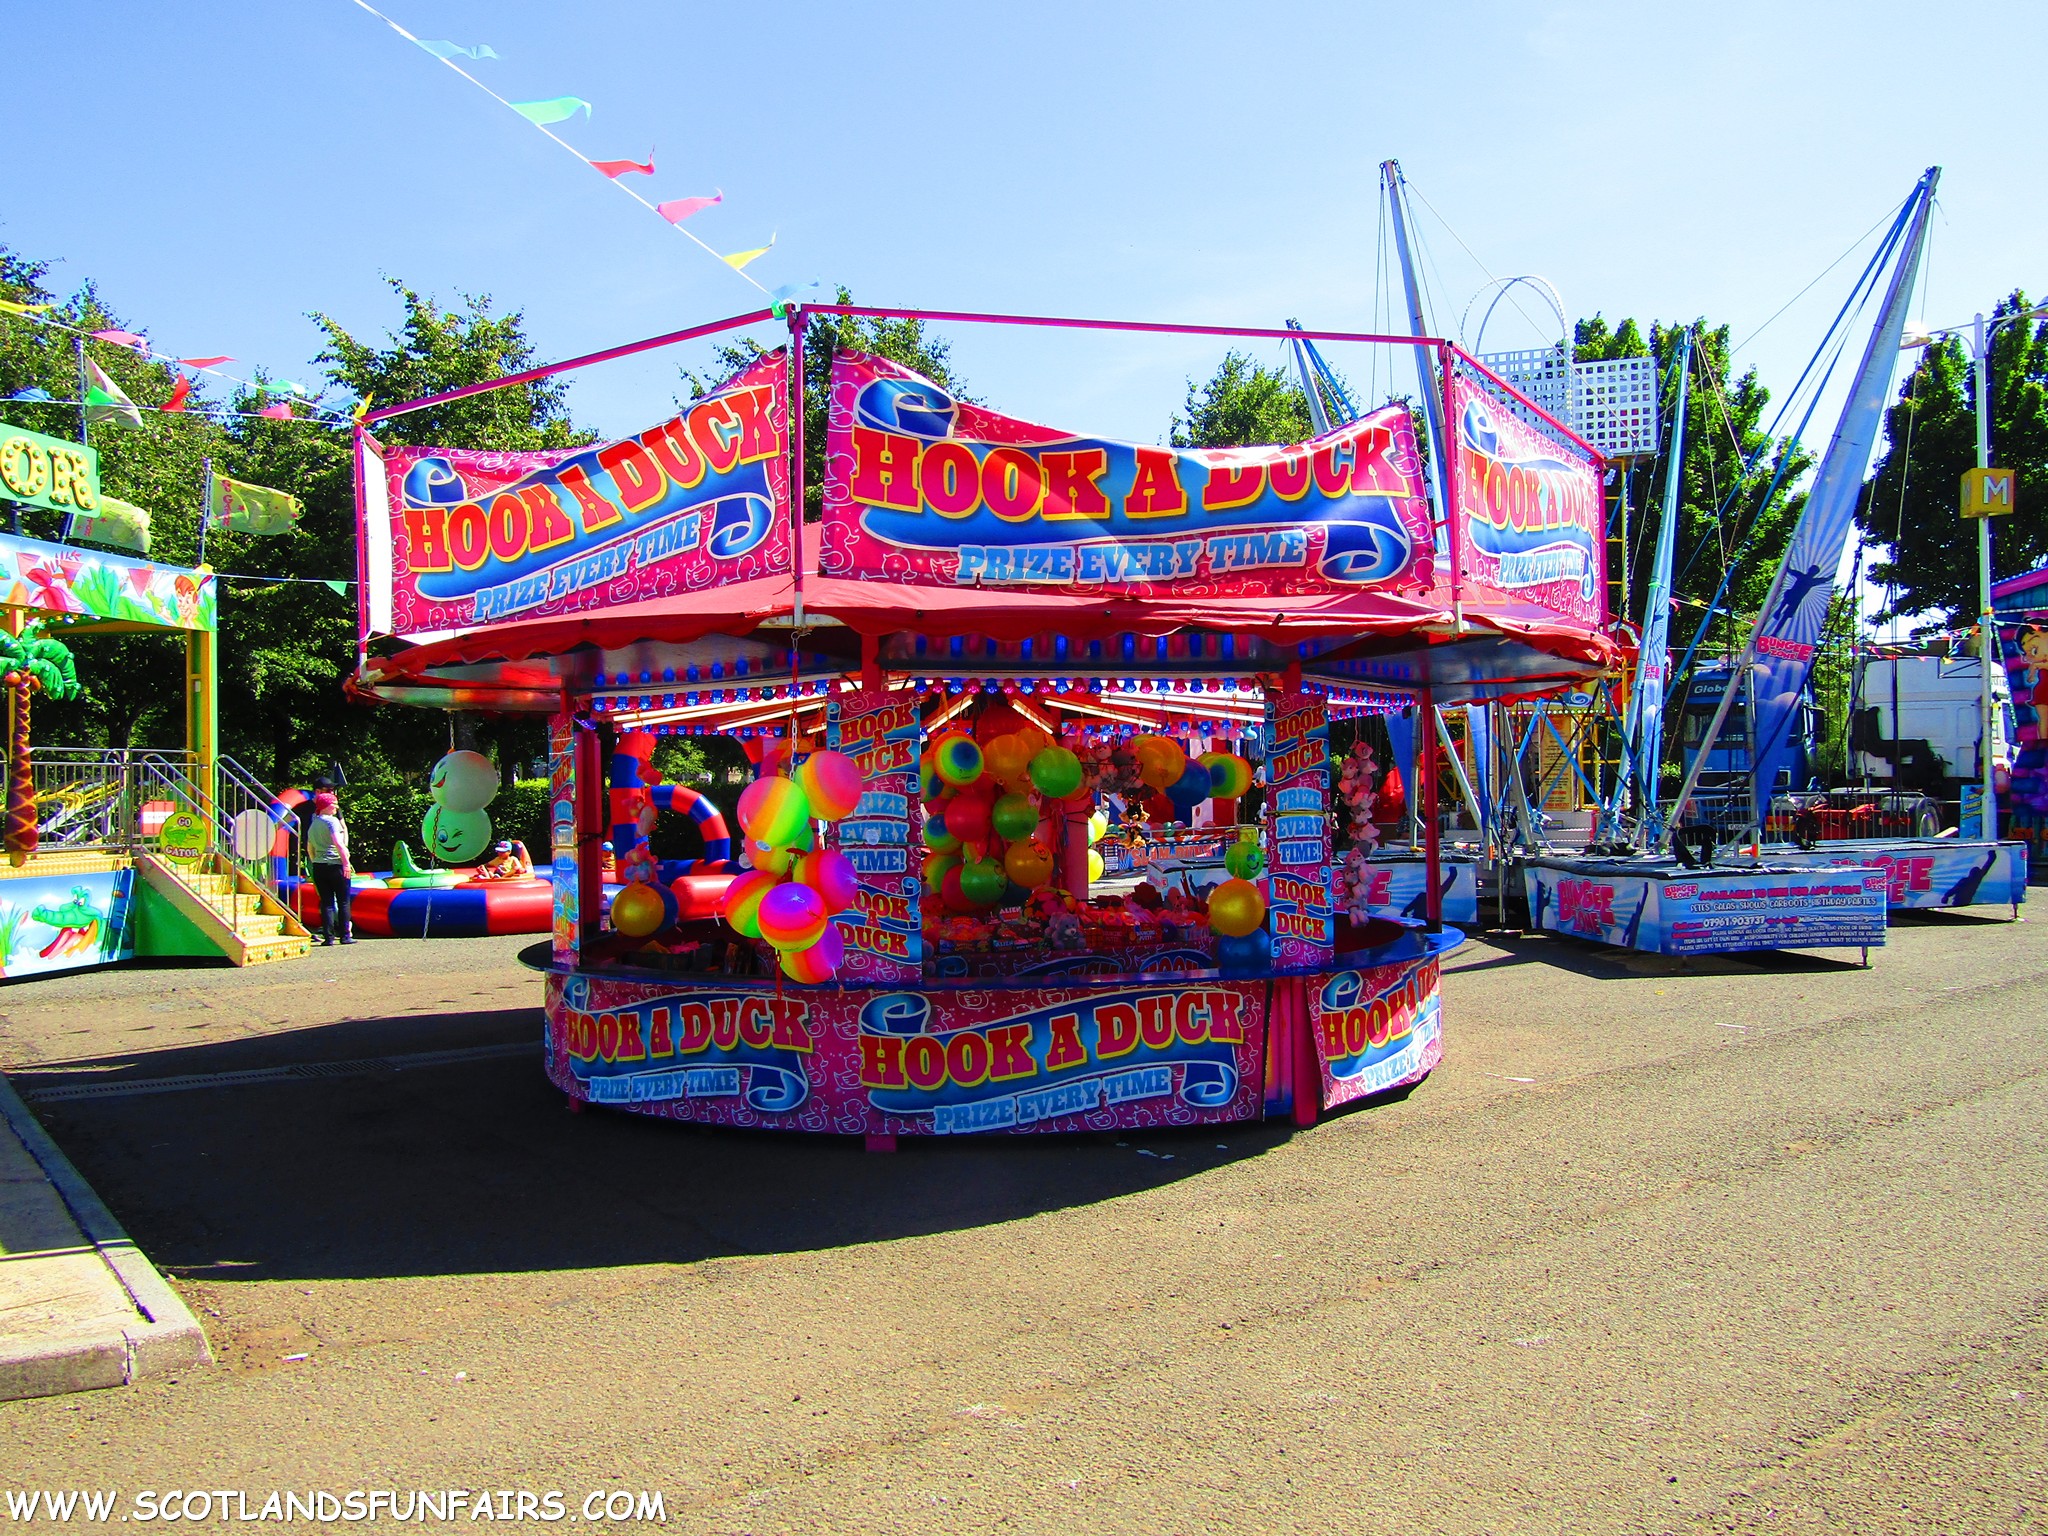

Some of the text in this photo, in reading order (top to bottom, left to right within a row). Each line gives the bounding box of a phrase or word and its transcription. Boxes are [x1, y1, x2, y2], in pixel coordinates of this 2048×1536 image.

[403, 384, 782, 573] HOOK A DUCK
[852, 426, 1410, 523] HOOK A DUCK
[1983, 476, 2008, 505] M
[1462, 447, 1597, 543] HOOK A DUCK
[471, 511, 701, 623] PRIZE EVERY TIME
[955, 527, 1310, 585] PRIZE EVERY TIME
[1498, 550, 1583, 589] PRIZE EVERY TIME
[1756, 635, 1815, 663] BUNGEE
[1769, 649, 1798, 661] ZONE
[839, 701, 915, 748] HOOK
[871, 728, 884, 751] A
[1274, 704, 1326, 746] HOOK
[1295, 727, 1307, 750] A
[1272, 738, 1326, 784] DUCK
[853, 791, 908, 820] RIZE
[1275, 788, 1323, 812] PRIZE
[177, 816, 192, 827] GO
[1275, 816, 1324, 840] EVERY
[164, 844, 199, 859] GATOR
[1131, 845, 1170, 867] SLAM
[1277, 841, 1324, 866] TIME!
[1273, 876, 1328, 909] HOOK
[1294, 897, 1307, 917] A
[1557, 878, 1617, 926] BUNGEE
[1663, 883, 1699, 899] BUNGEE
[1672, 891, 1692, 900] ZONE
[1713, 901, 1737, 911] GALAS
[1740, 900, 1767, 911] SHOWS
[1769, 898, 1809, 908] CARBOOTS
[1811, 897, 1847, 907] BIRTHDAY
[1847, 896, 1877, 906] PARTIES
[865, 908, 881, 931] A
[1275, 911, 1327, 943] DUCK
[836, 920, 911, 958] DUCK
[566, 997, 814, 1063] HOOK A DUCK
[1320, 985, 1413, 1061] HOOK
[1404, 977, 1419, 1023] A
[858, 991, 1244, 1090] HOOK A DUCK
[588, 1068, 740, 1103] PRIZE EVERY TIME
[1362, 1053, 1410, 1093] PRIZE
[933, 1066, 1173, 1136] PRIZE EVERY TIME
